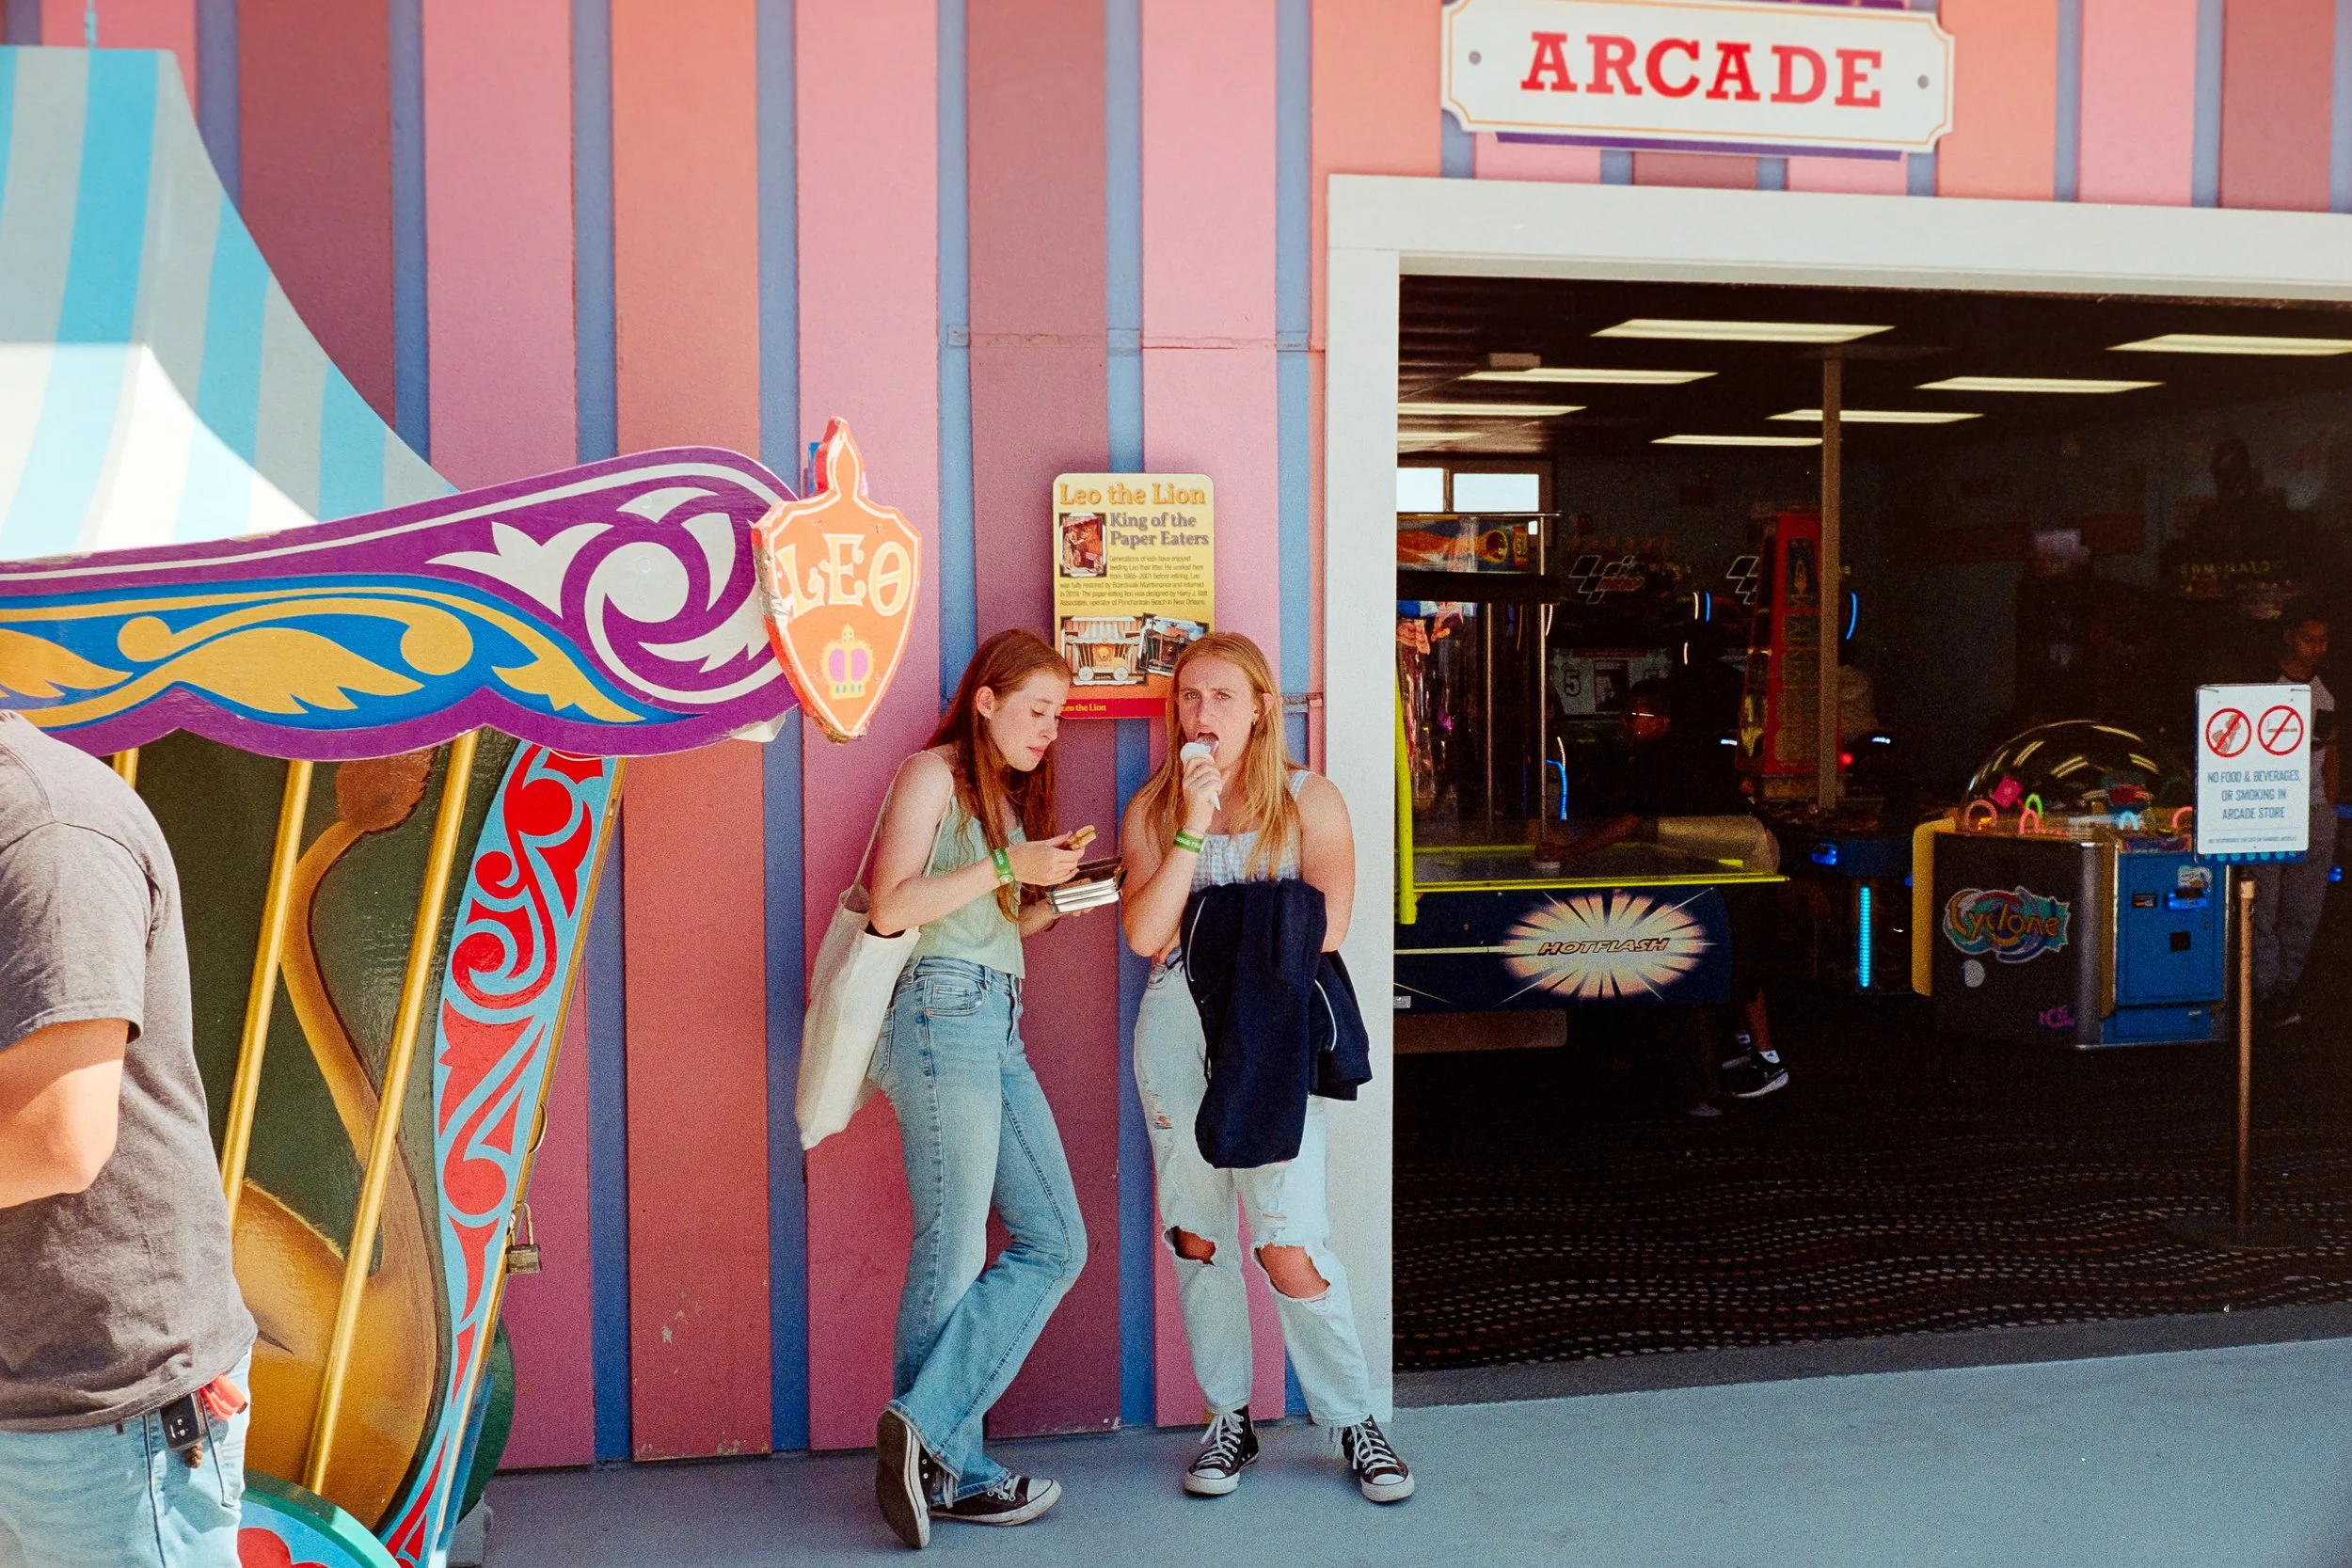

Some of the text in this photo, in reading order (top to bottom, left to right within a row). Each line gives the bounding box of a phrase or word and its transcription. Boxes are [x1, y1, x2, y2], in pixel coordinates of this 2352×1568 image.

[1520, 31, 1882, 108] ARCADE
[1059, 483, 1206, 505] Leo the Lion
[1110, 512, 1197, 531] King of the
[1110, 531, 1210, 549] Paper Eaters
[774, 533, 912, 619] LEO
[1075, 704, 1089, 712] the
[1089, 704, 1106, 712] Lion
[2207, 771, 2219, 783] NO
[2220, 770, 2242, 783] FOOD
[2244, 770, 2250, 783] &
[2221, 788, 2286, 801] OR SMOKING IN
[2222, 807, 2285, 820] ARCADE STORE
[1948, 891, 2063, 942] Cyclone
[1537, 937, 1671, 957] HOTFLASH
